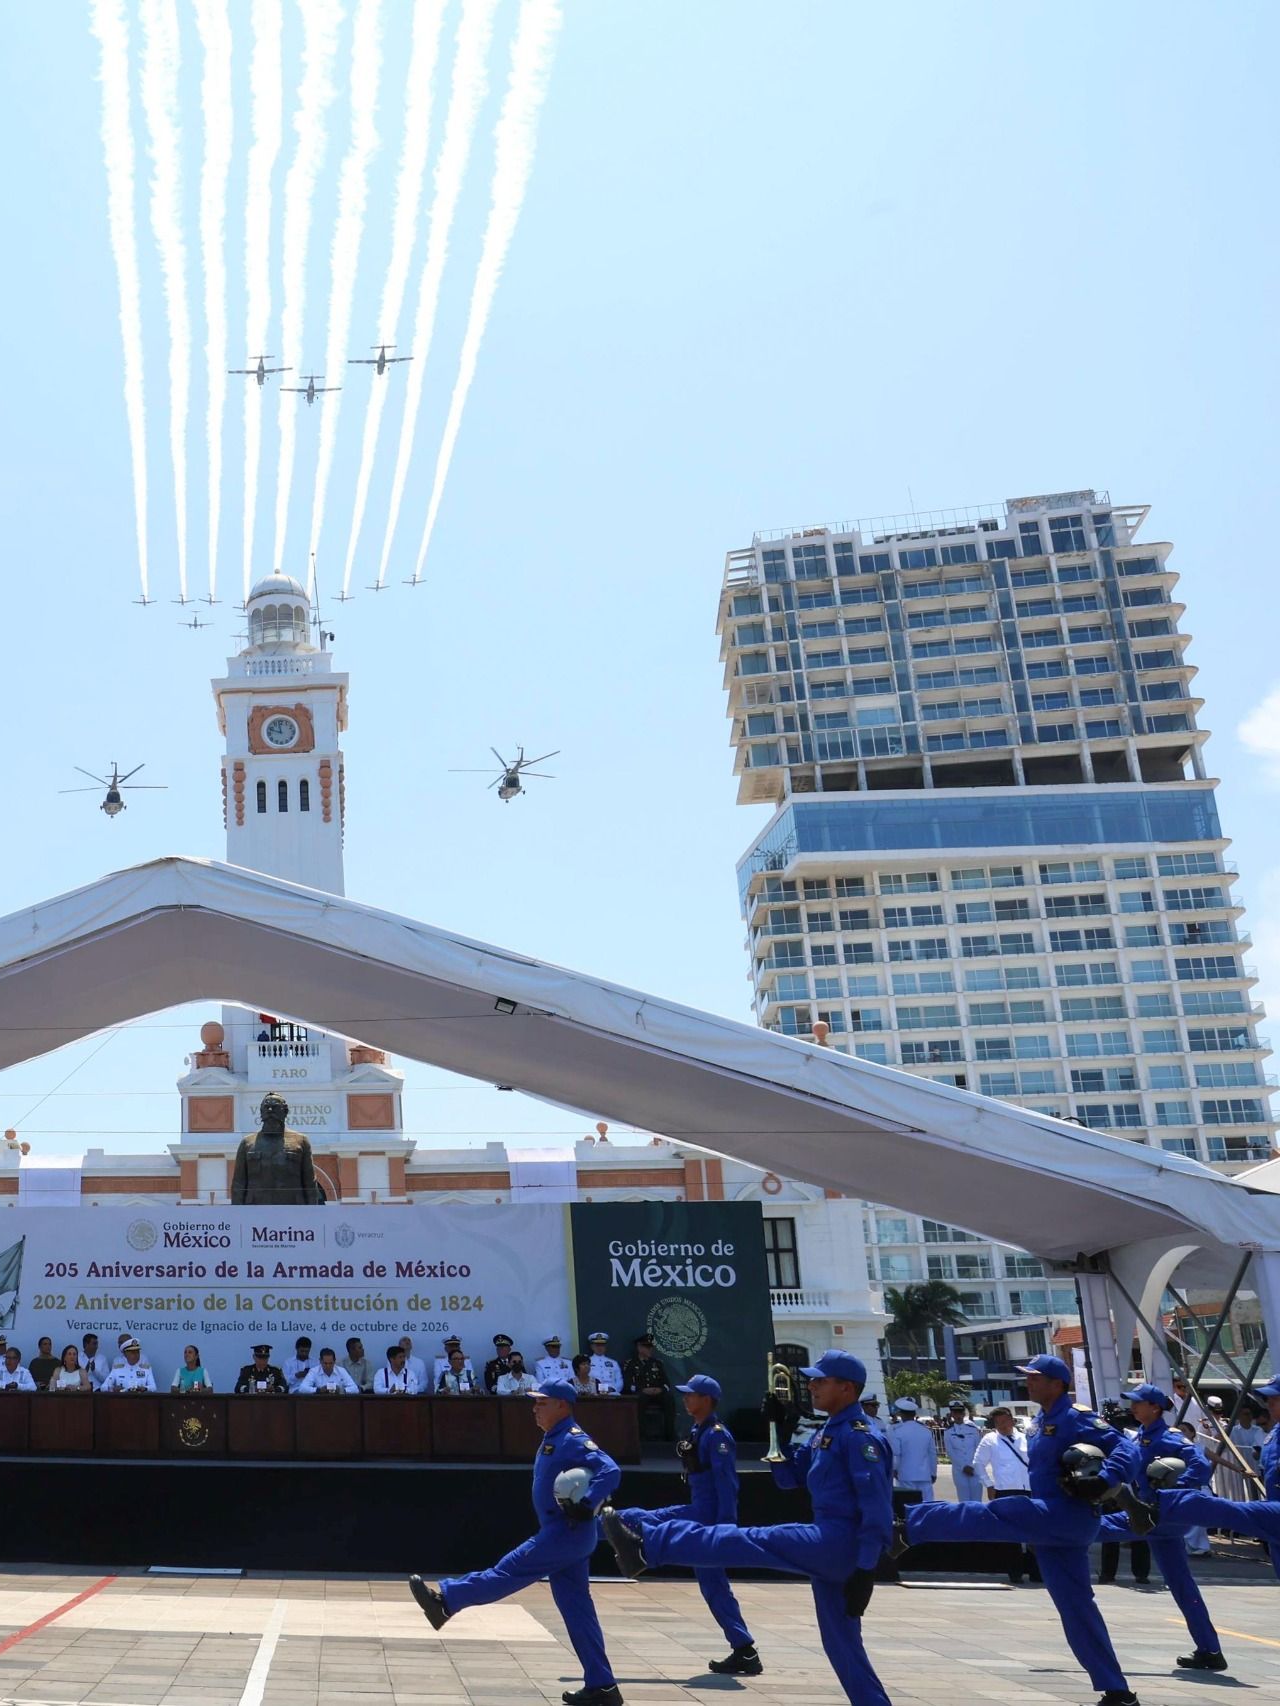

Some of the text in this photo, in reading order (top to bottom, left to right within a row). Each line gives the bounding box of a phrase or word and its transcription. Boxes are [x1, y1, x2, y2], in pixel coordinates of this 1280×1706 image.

[272, 1068, 308, 1079] FARO
[254, 1116, 327, 1126] CRANZA
[163, 1221, 231, 1231] Gobierno de
[251, 1226, 315, 1242] Marina
[163, 1231, 231, 1249] México
[608, 1239, 735, 1256] Gobierno de
[44, 1259, 471, 1278] 205 Aniversario de la Armada de México
[609, 1258, 737, 1288] México
[32, 1292, 485, 1311] 202 Aniversario de la Constitución de 1824
[66, 1319, 450, 1334] Veracruz, Veracruz de Ignacio de la Llave, 4 de octubre de 2026
